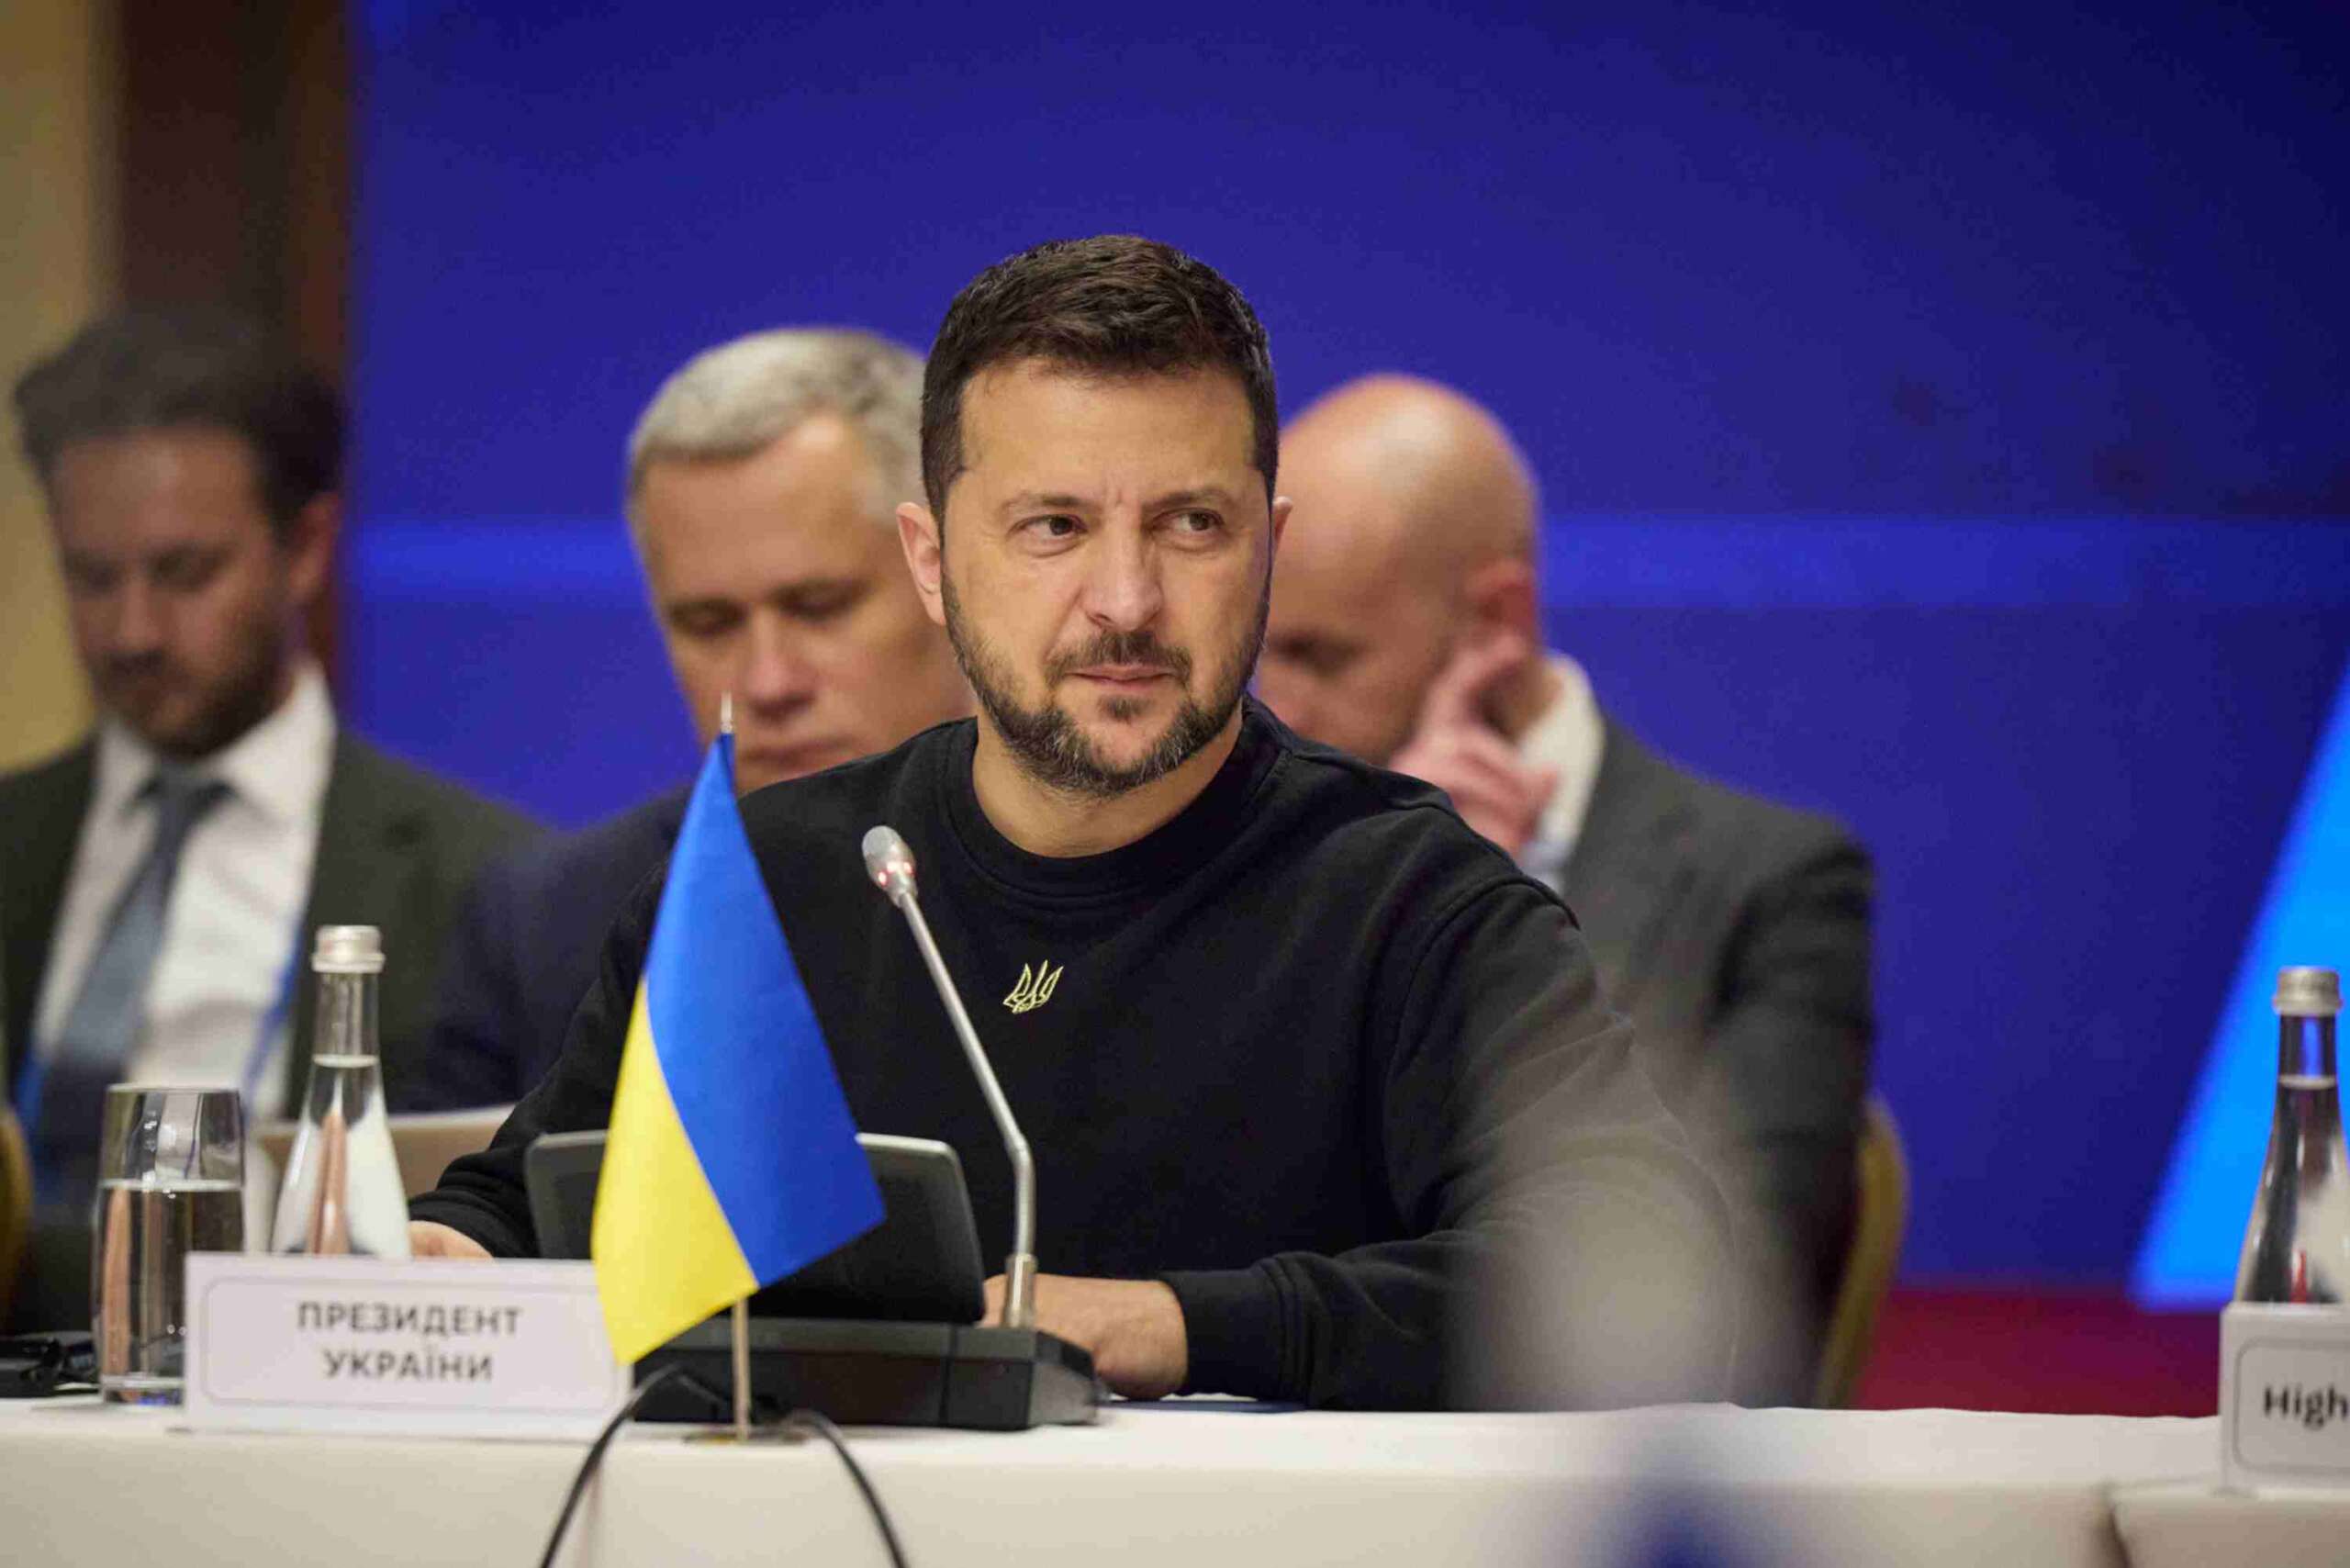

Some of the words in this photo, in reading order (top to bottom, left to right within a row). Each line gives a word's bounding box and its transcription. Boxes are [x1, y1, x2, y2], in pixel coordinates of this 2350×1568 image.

[298, 1300, 521, 1338] ПРЕЗИДЕНТ
[323, 1347, 493, 1382] УКРАЇНИ
[2264, 1383, 2350, 1430] High
